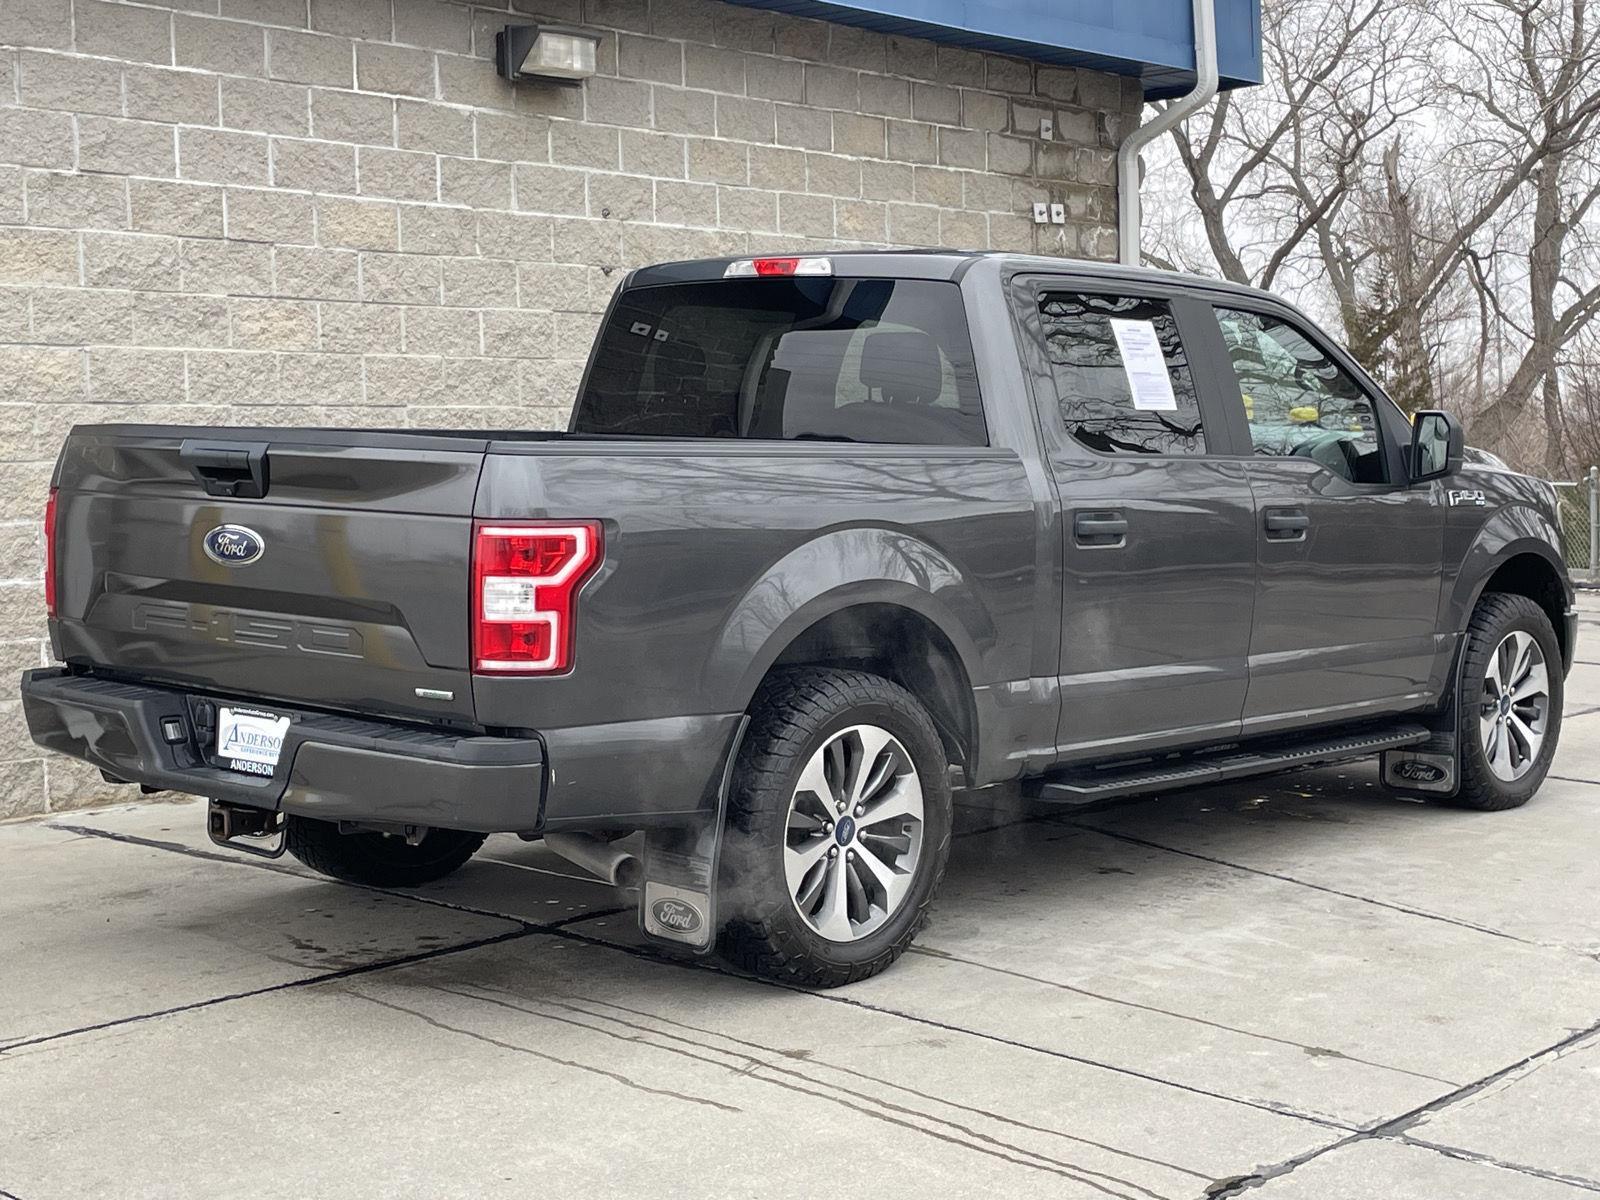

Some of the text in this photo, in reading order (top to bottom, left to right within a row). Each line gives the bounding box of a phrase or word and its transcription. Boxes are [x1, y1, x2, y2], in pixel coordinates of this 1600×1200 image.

[214, 532, 248, 557] Ford
[131, 602, 365, 659] F-150
[223, 723, 281, 750] ANDERSO
[230, 758, 274, 776] ANDERSON
[1402, 762, 1436, 781] Ford
[660, 902, 693, 928] Ford
